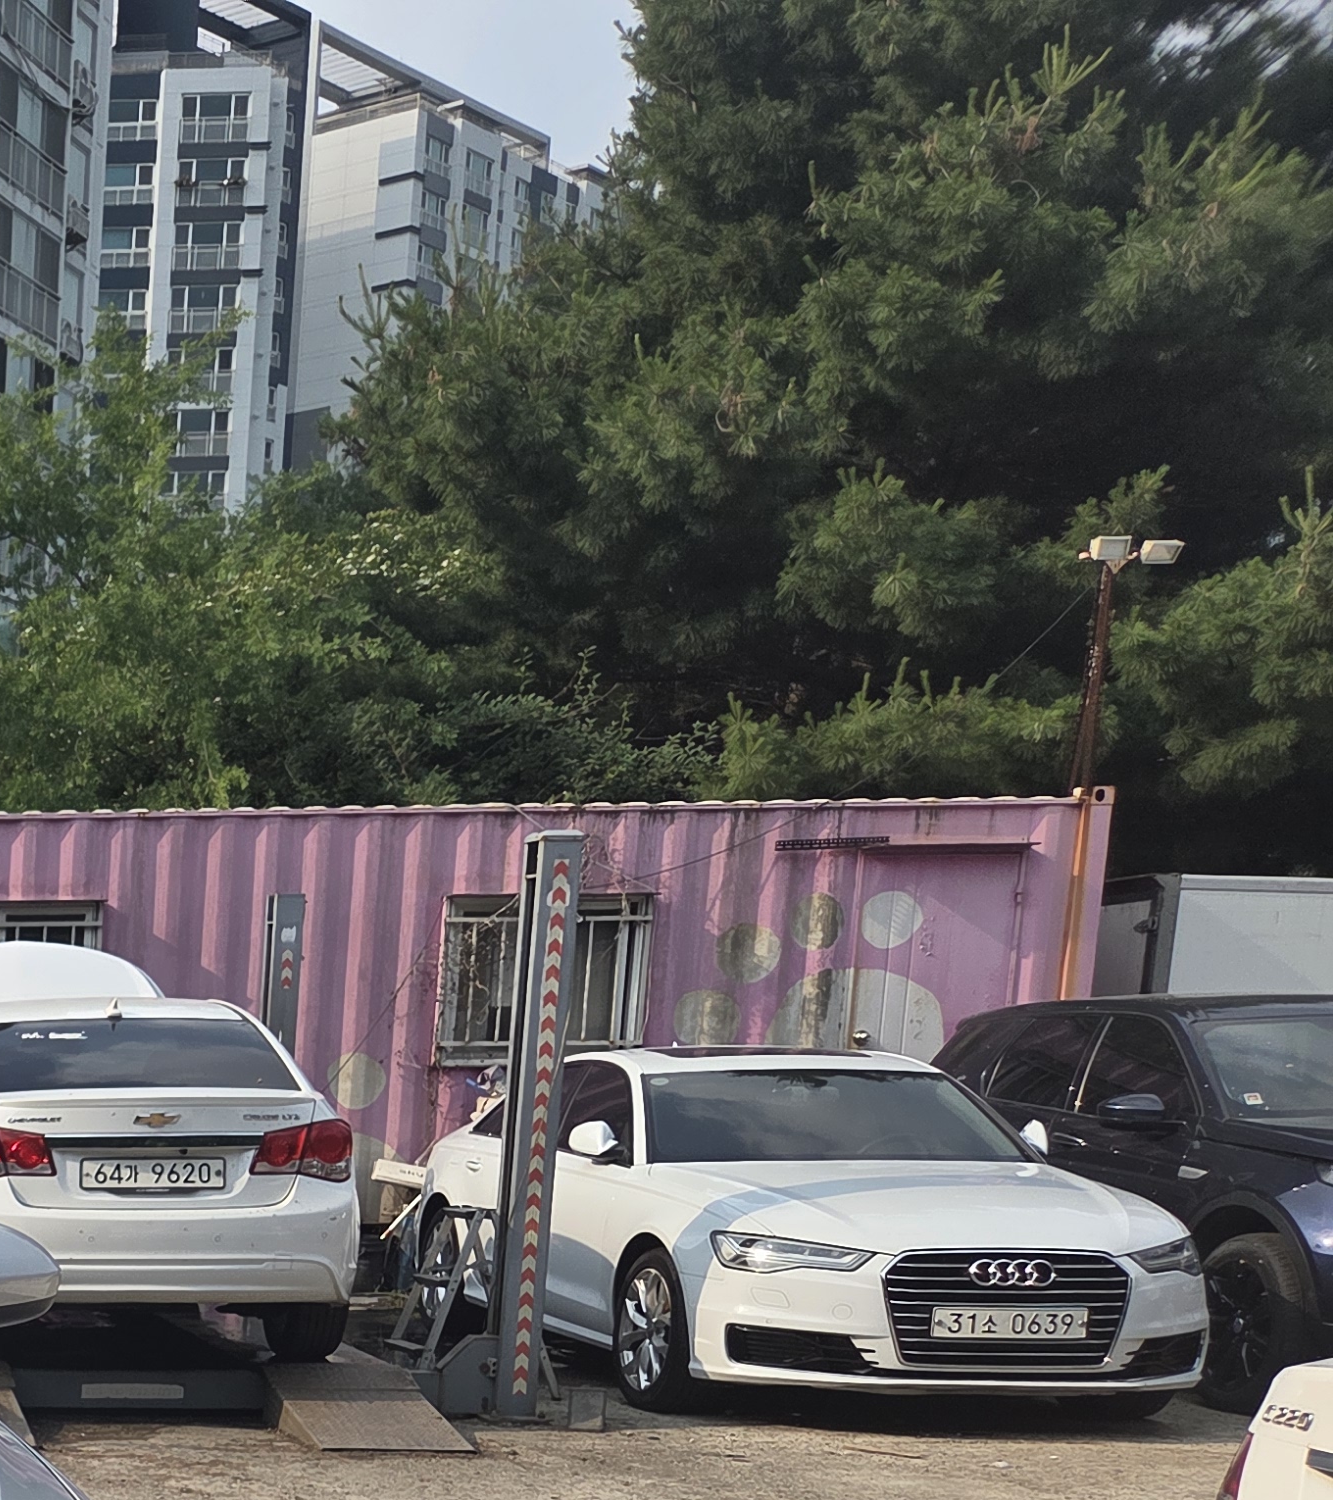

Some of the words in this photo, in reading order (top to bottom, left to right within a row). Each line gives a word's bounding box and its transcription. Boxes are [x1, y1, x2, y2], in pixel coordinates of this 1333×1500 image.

[94, 1162, 139, 1184] 64가
[151, 1162, 211, 1184] 9620
[947, 1313, 998, 1334] 31소
[1011, 1313, 1074, 1335] 0639
